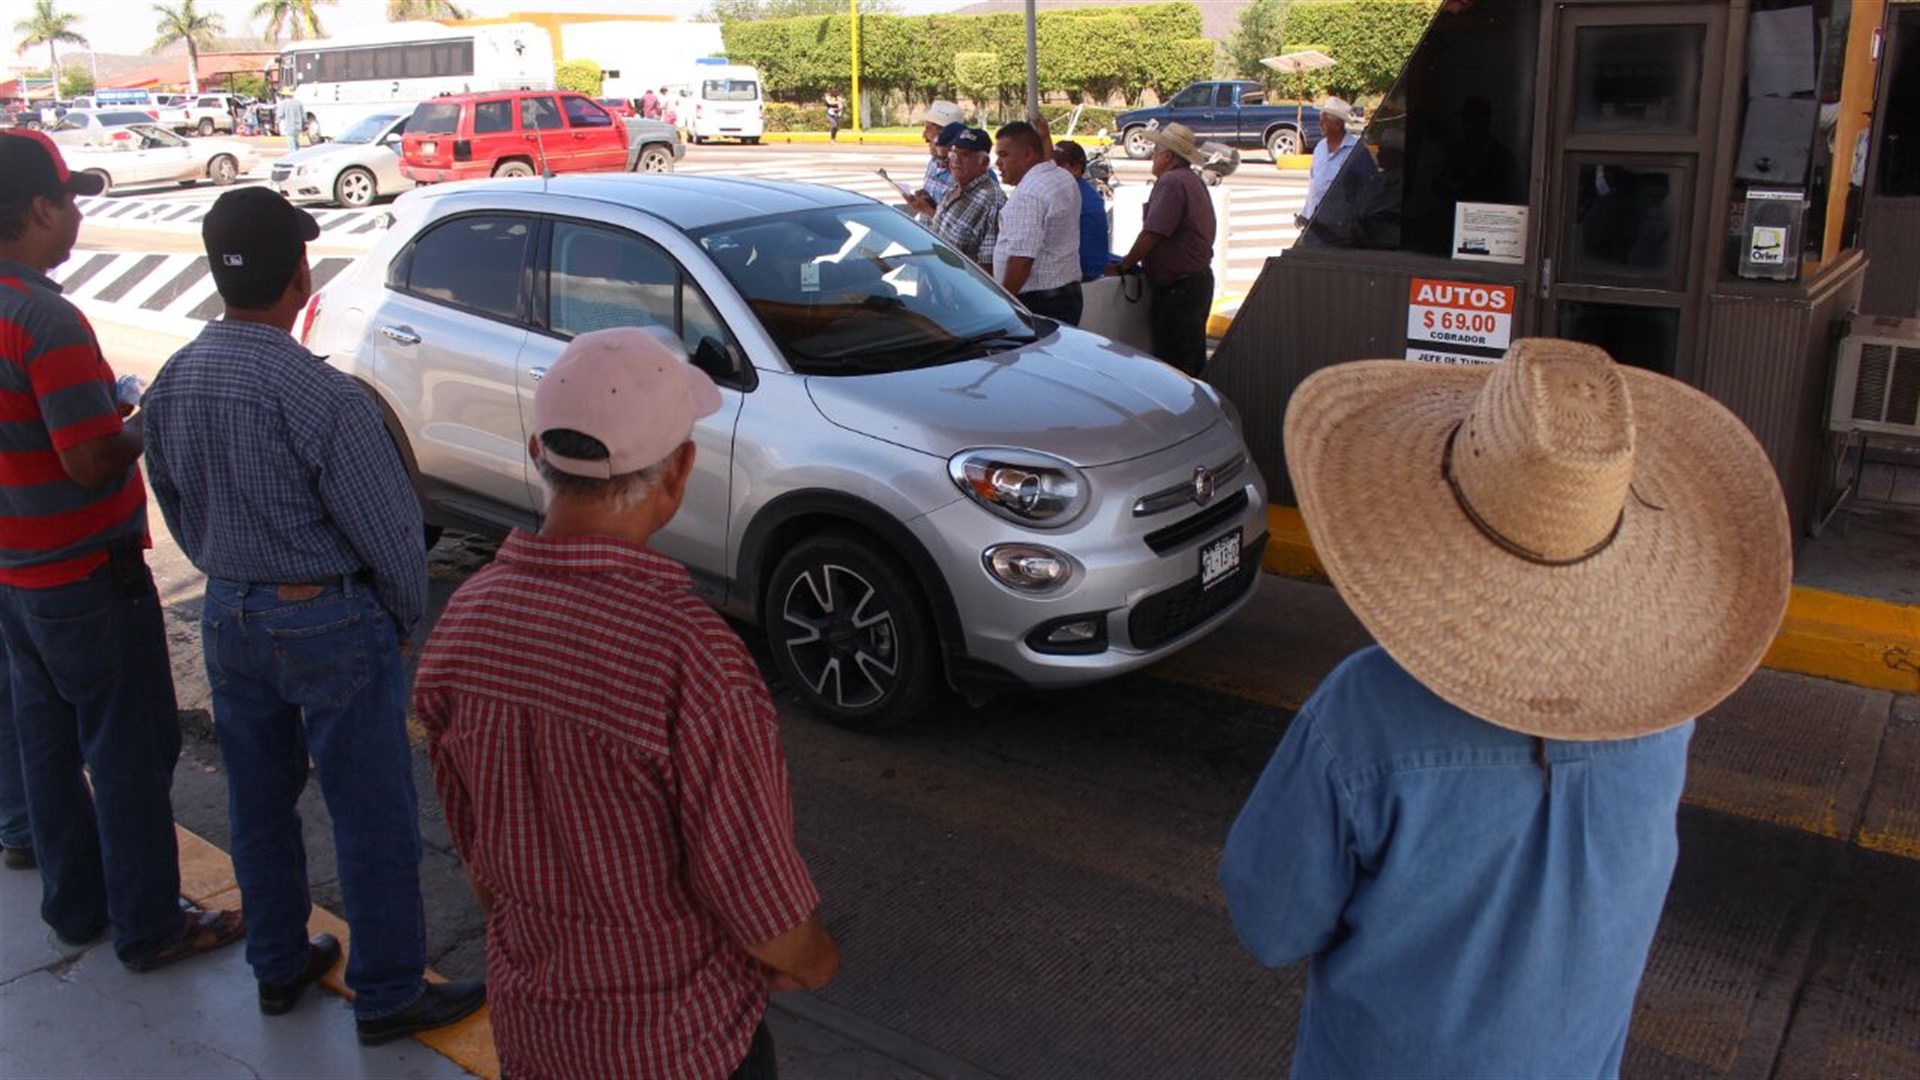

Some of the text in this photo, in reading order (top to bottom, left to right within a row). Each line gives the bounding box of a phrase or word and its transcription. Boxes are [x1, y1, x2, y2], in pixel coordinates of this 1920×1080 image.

[1417, 284, 1506, 309] AUTOS
[1423, 310, 1496, 333] $ 69.00
[1430, 331, 1486, 344] COBRADOR
[1418, 353, 1442, 363] JEFE
